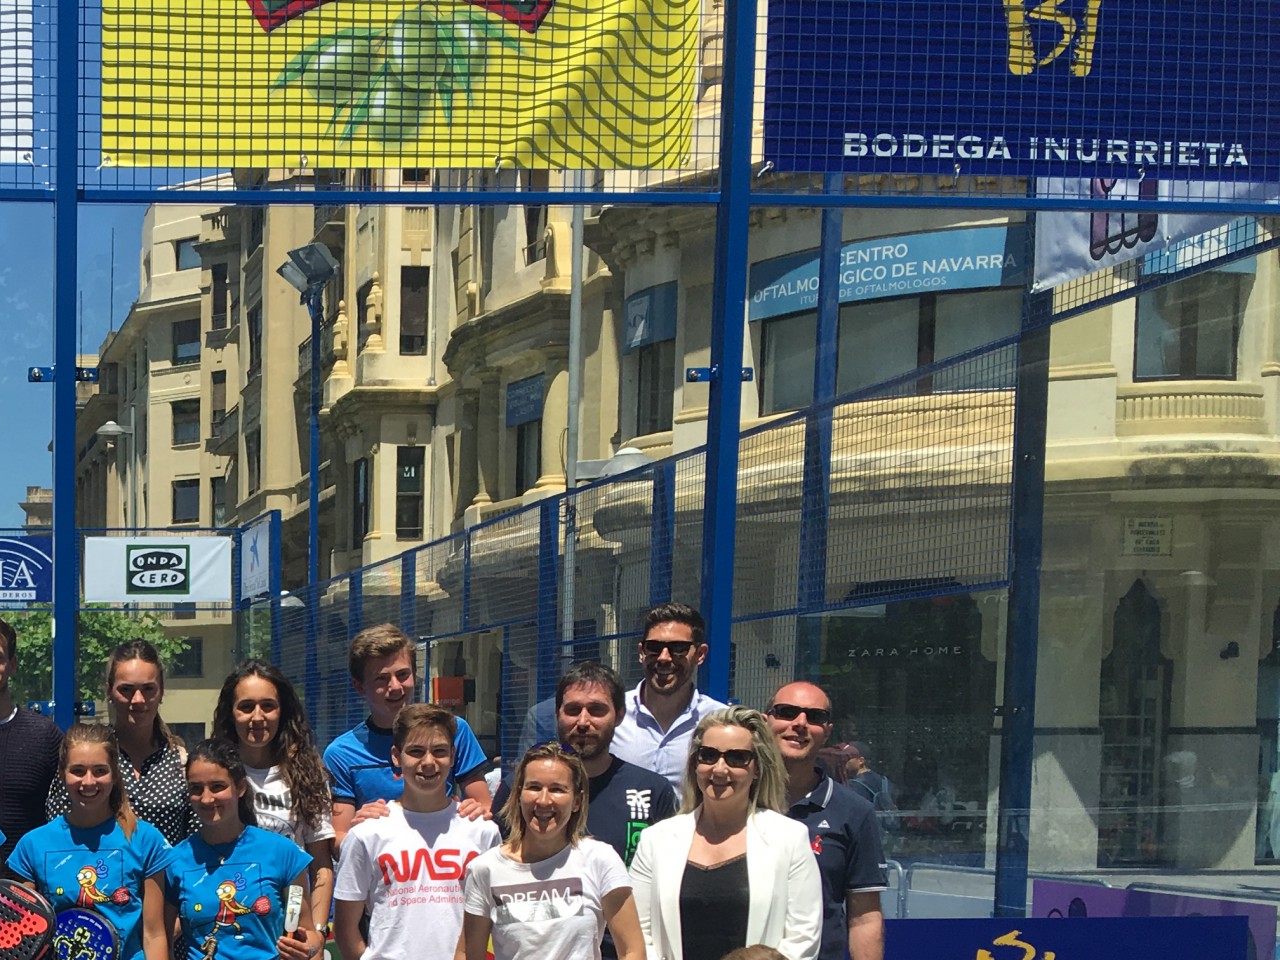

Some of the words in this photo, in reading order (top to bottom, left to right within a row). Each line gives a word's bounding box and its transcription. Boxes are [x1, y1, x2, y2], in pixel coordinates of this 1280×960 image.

[843, 132, 1012, 160] BODEGA
[1029, 136, 1249, 167] INURRIETA
[840, 243, 908, 267] ENTRO
[753, 267, 886, 304] OFTALMOGICO
[892, 262, 918, 278] DE
[922, 254, 1018, 275] NAVARRA
[855, 276, 947, 299] OFTALMOLOGOS
[136, 556, 179, 567] ONDA
[138, 573, 179, 585] CERO
[848, 648, 900, 657] ZARA
[910, 646, 962, 656] HOME
[400, 895, 427, 907] Space
